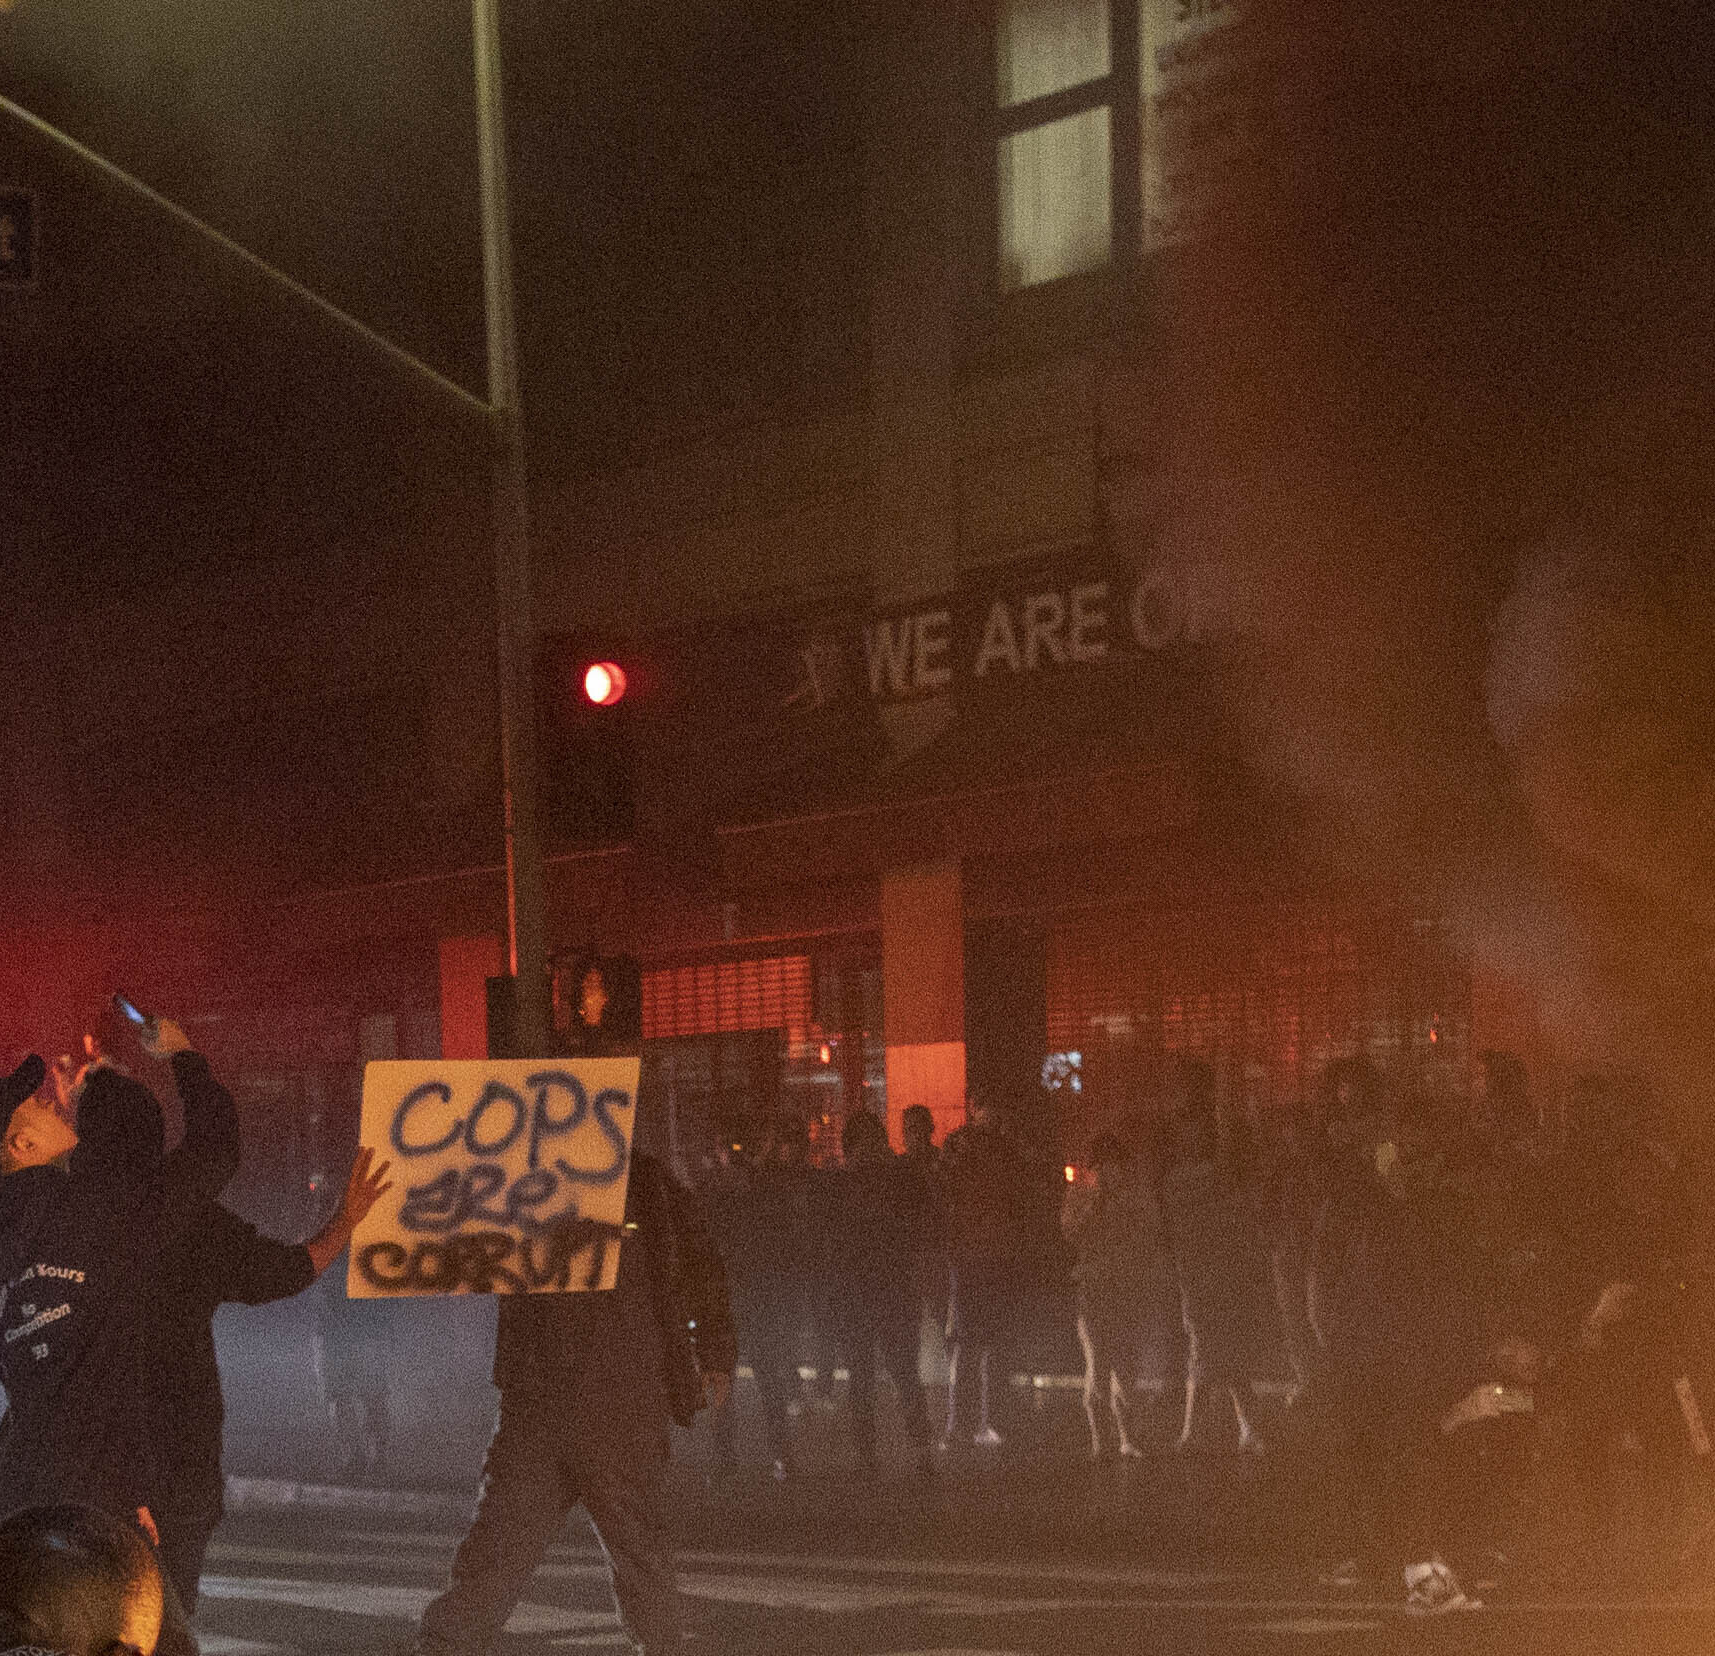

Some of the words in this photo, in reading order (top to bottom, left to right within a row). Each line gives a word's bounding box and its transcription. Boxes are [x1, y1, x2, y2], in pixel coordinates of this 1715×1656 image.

[863, 609, 952, 695] WE
[975, 581, 1108, 677] ARE
[389, 1070, 630, 1185] COPS
